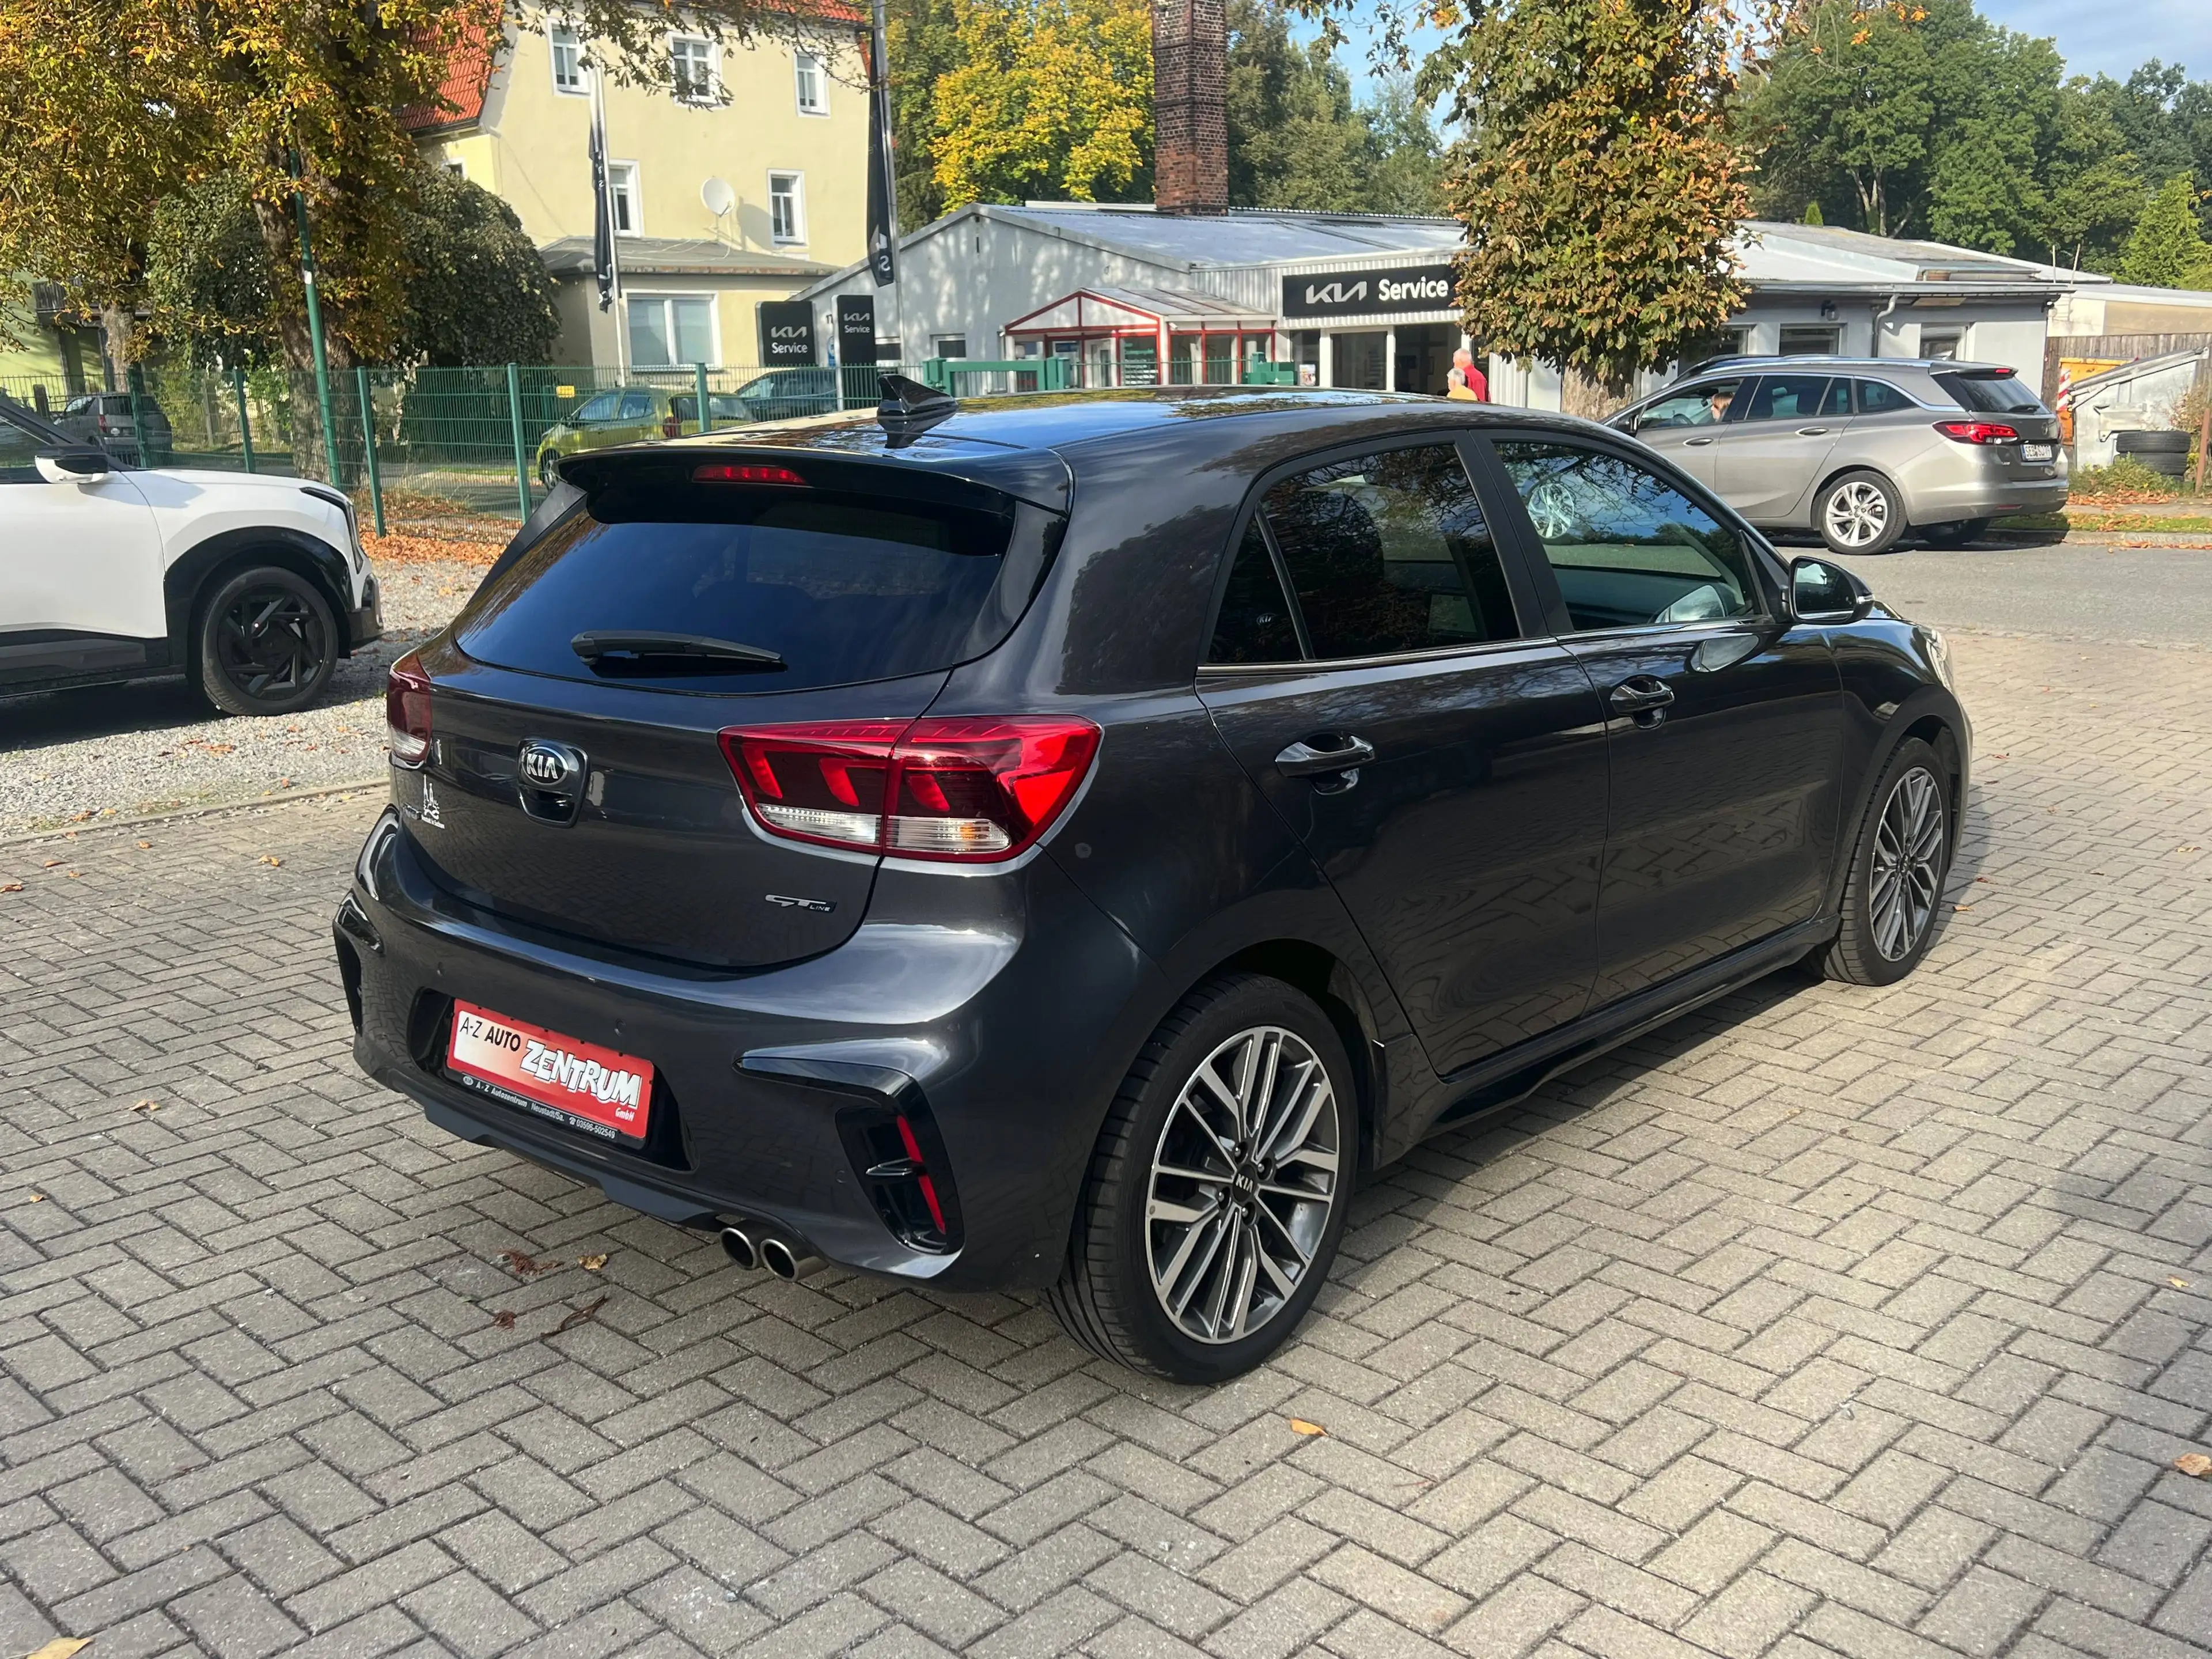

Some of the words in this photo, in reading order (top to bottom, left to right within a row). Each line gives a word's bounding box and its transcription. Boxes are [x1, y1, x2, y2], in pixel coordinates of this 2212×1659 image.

[1306, 281, 1367, 304] KIA
[1378, 276, 1449, 301] Service
[843, 313, 870, 321] KIA
[771, 326, 807, 338] KIA
[844, 324, 870, 334] Service
[772, 342, 808, 354] Service
[527, 753, 558, 779] KIA
[765, 894, 827, 907] GT
[460, 1017, 483, 1039] A-Z
[484, 1026, 521, 1052] AUTO
[520, 1039, 642, 1110] ZENTRUM
[491, 1087, 528, 1108] Autozentrum
[576, 1119, 615, 1139] 03596-502549
[615, 1107, 635, 1122] GmbH
[1236, 1173, 1253, 1193] KIA
